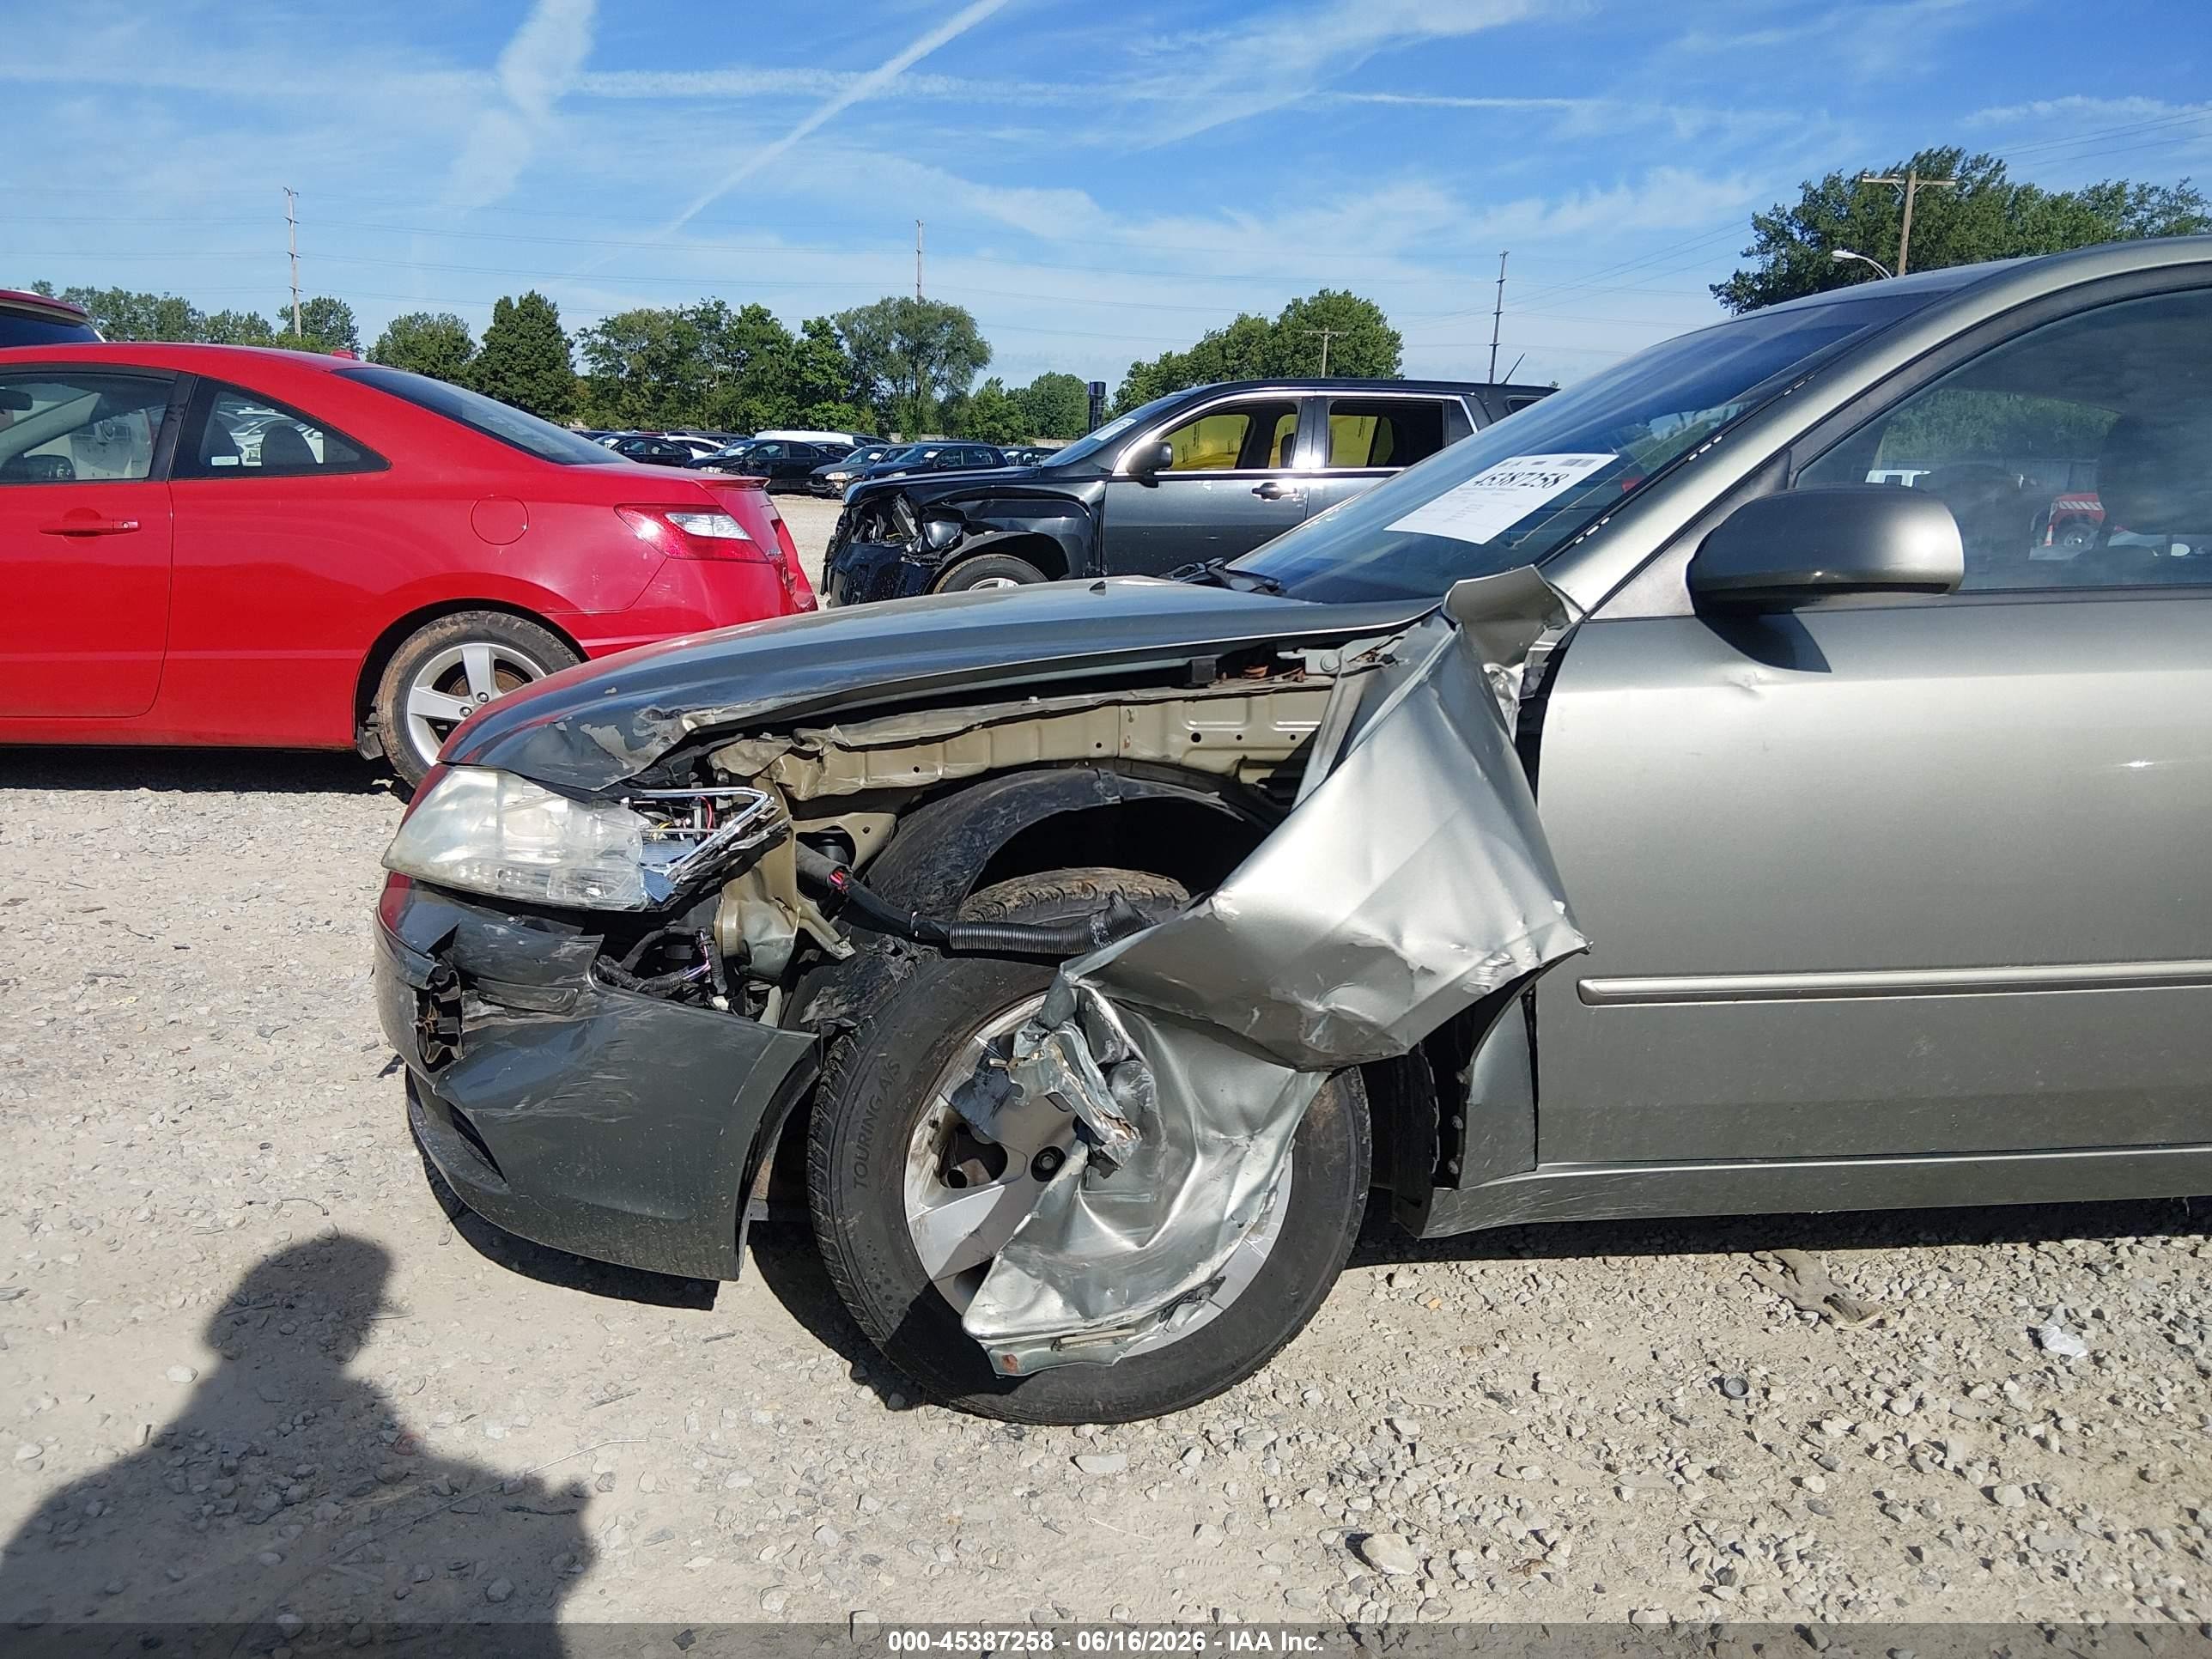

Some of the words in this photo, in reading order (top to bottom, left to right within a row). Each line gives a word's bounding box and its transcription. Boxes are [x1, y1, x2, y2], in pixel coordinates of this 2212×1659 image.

[1474, 471, 1570, 489] 45387258
[853, 1094, 882, 1190] TOURING
[878, 1058, 901, 1094] A/S
